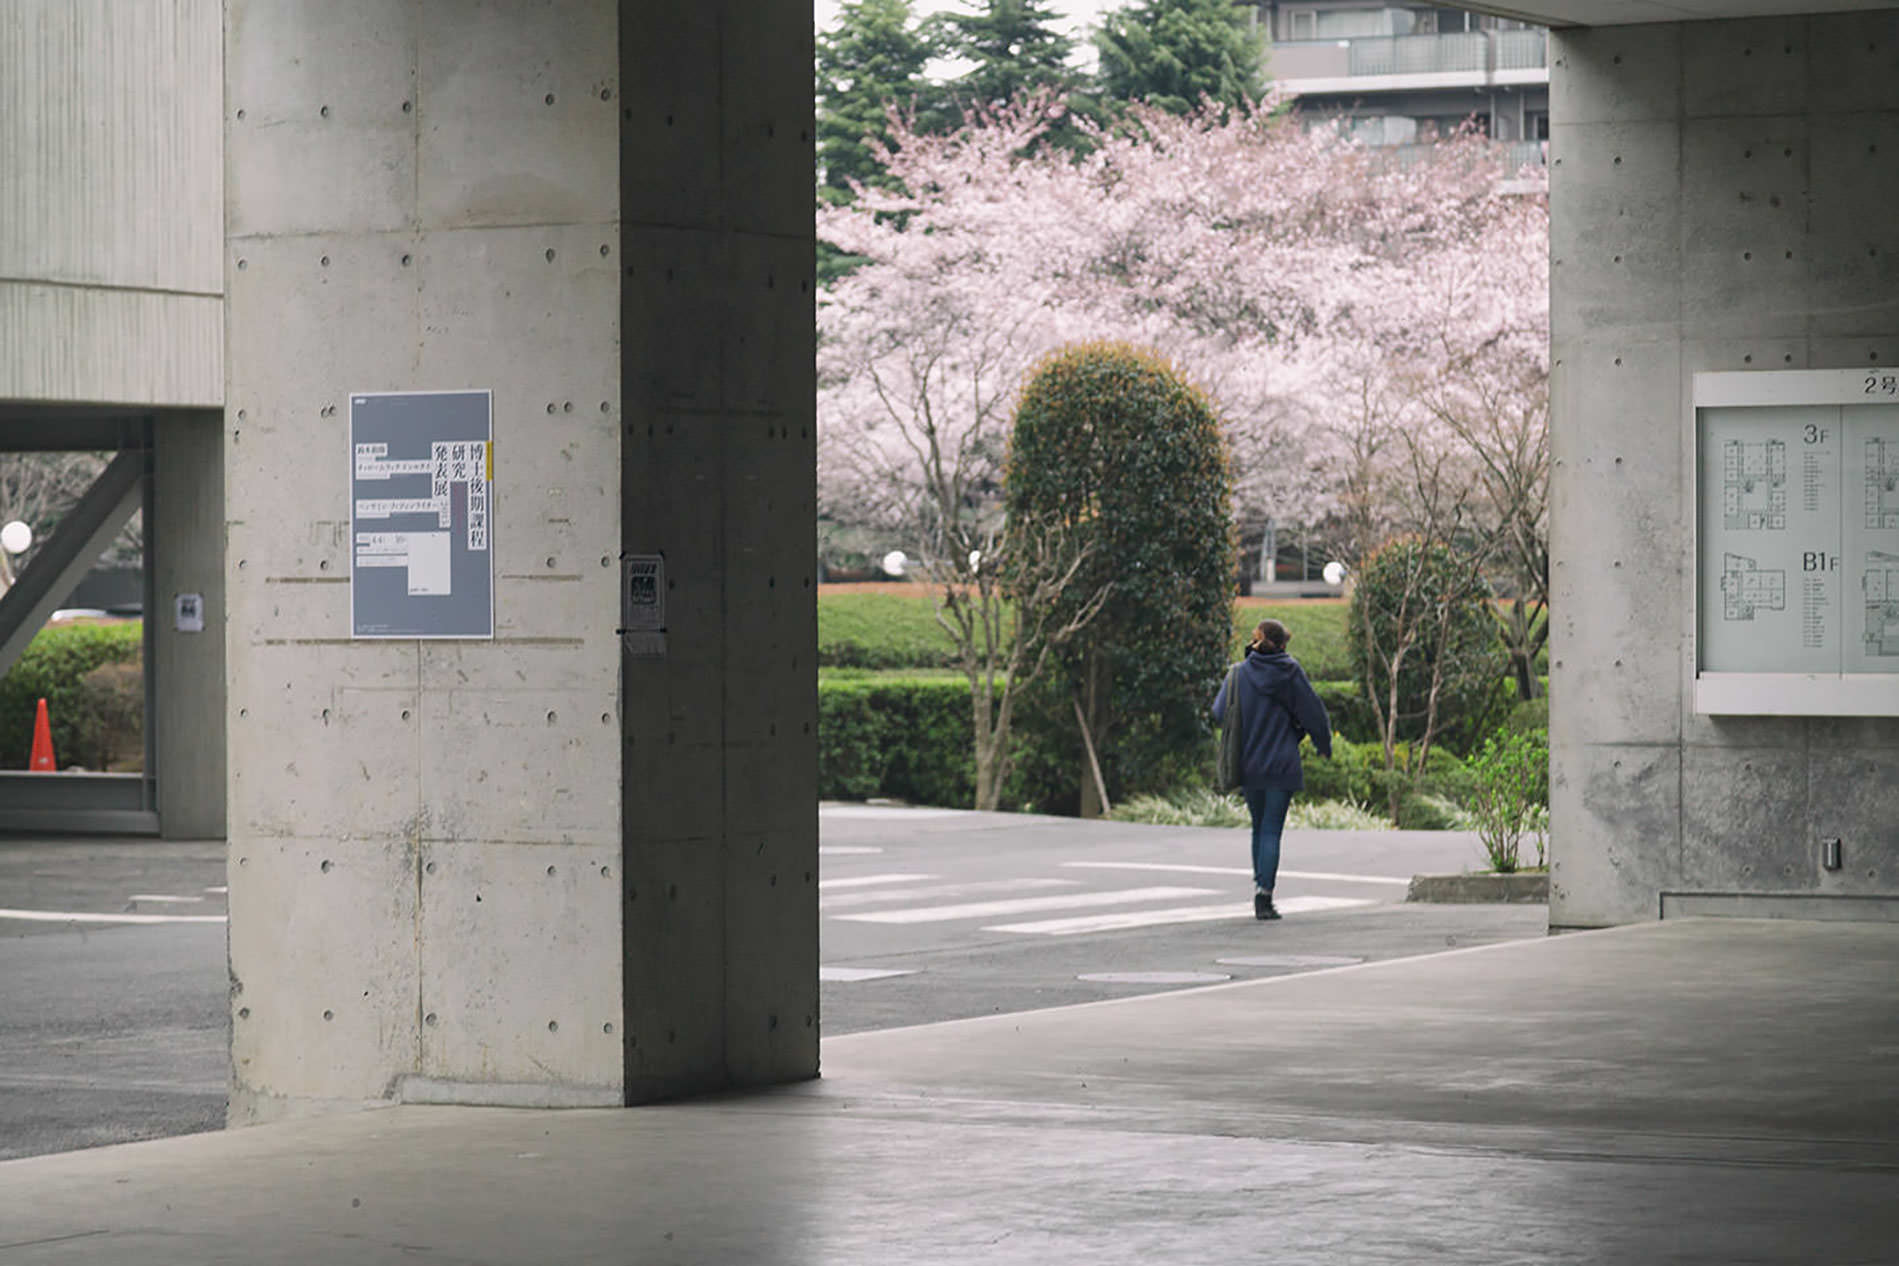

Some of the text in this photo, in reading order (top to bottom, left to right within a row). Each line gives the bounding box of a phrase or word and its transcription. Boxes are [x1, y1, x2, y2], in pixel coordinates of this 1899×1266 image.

[1803, 424, 1829, 444] 3F
[434, 445, 449, 497] 発表展
[452, 444, 467, 479] 研究
[470, 443, 485, 549] 博士後期課程
[1803, 552, 1840, 572] B1F
